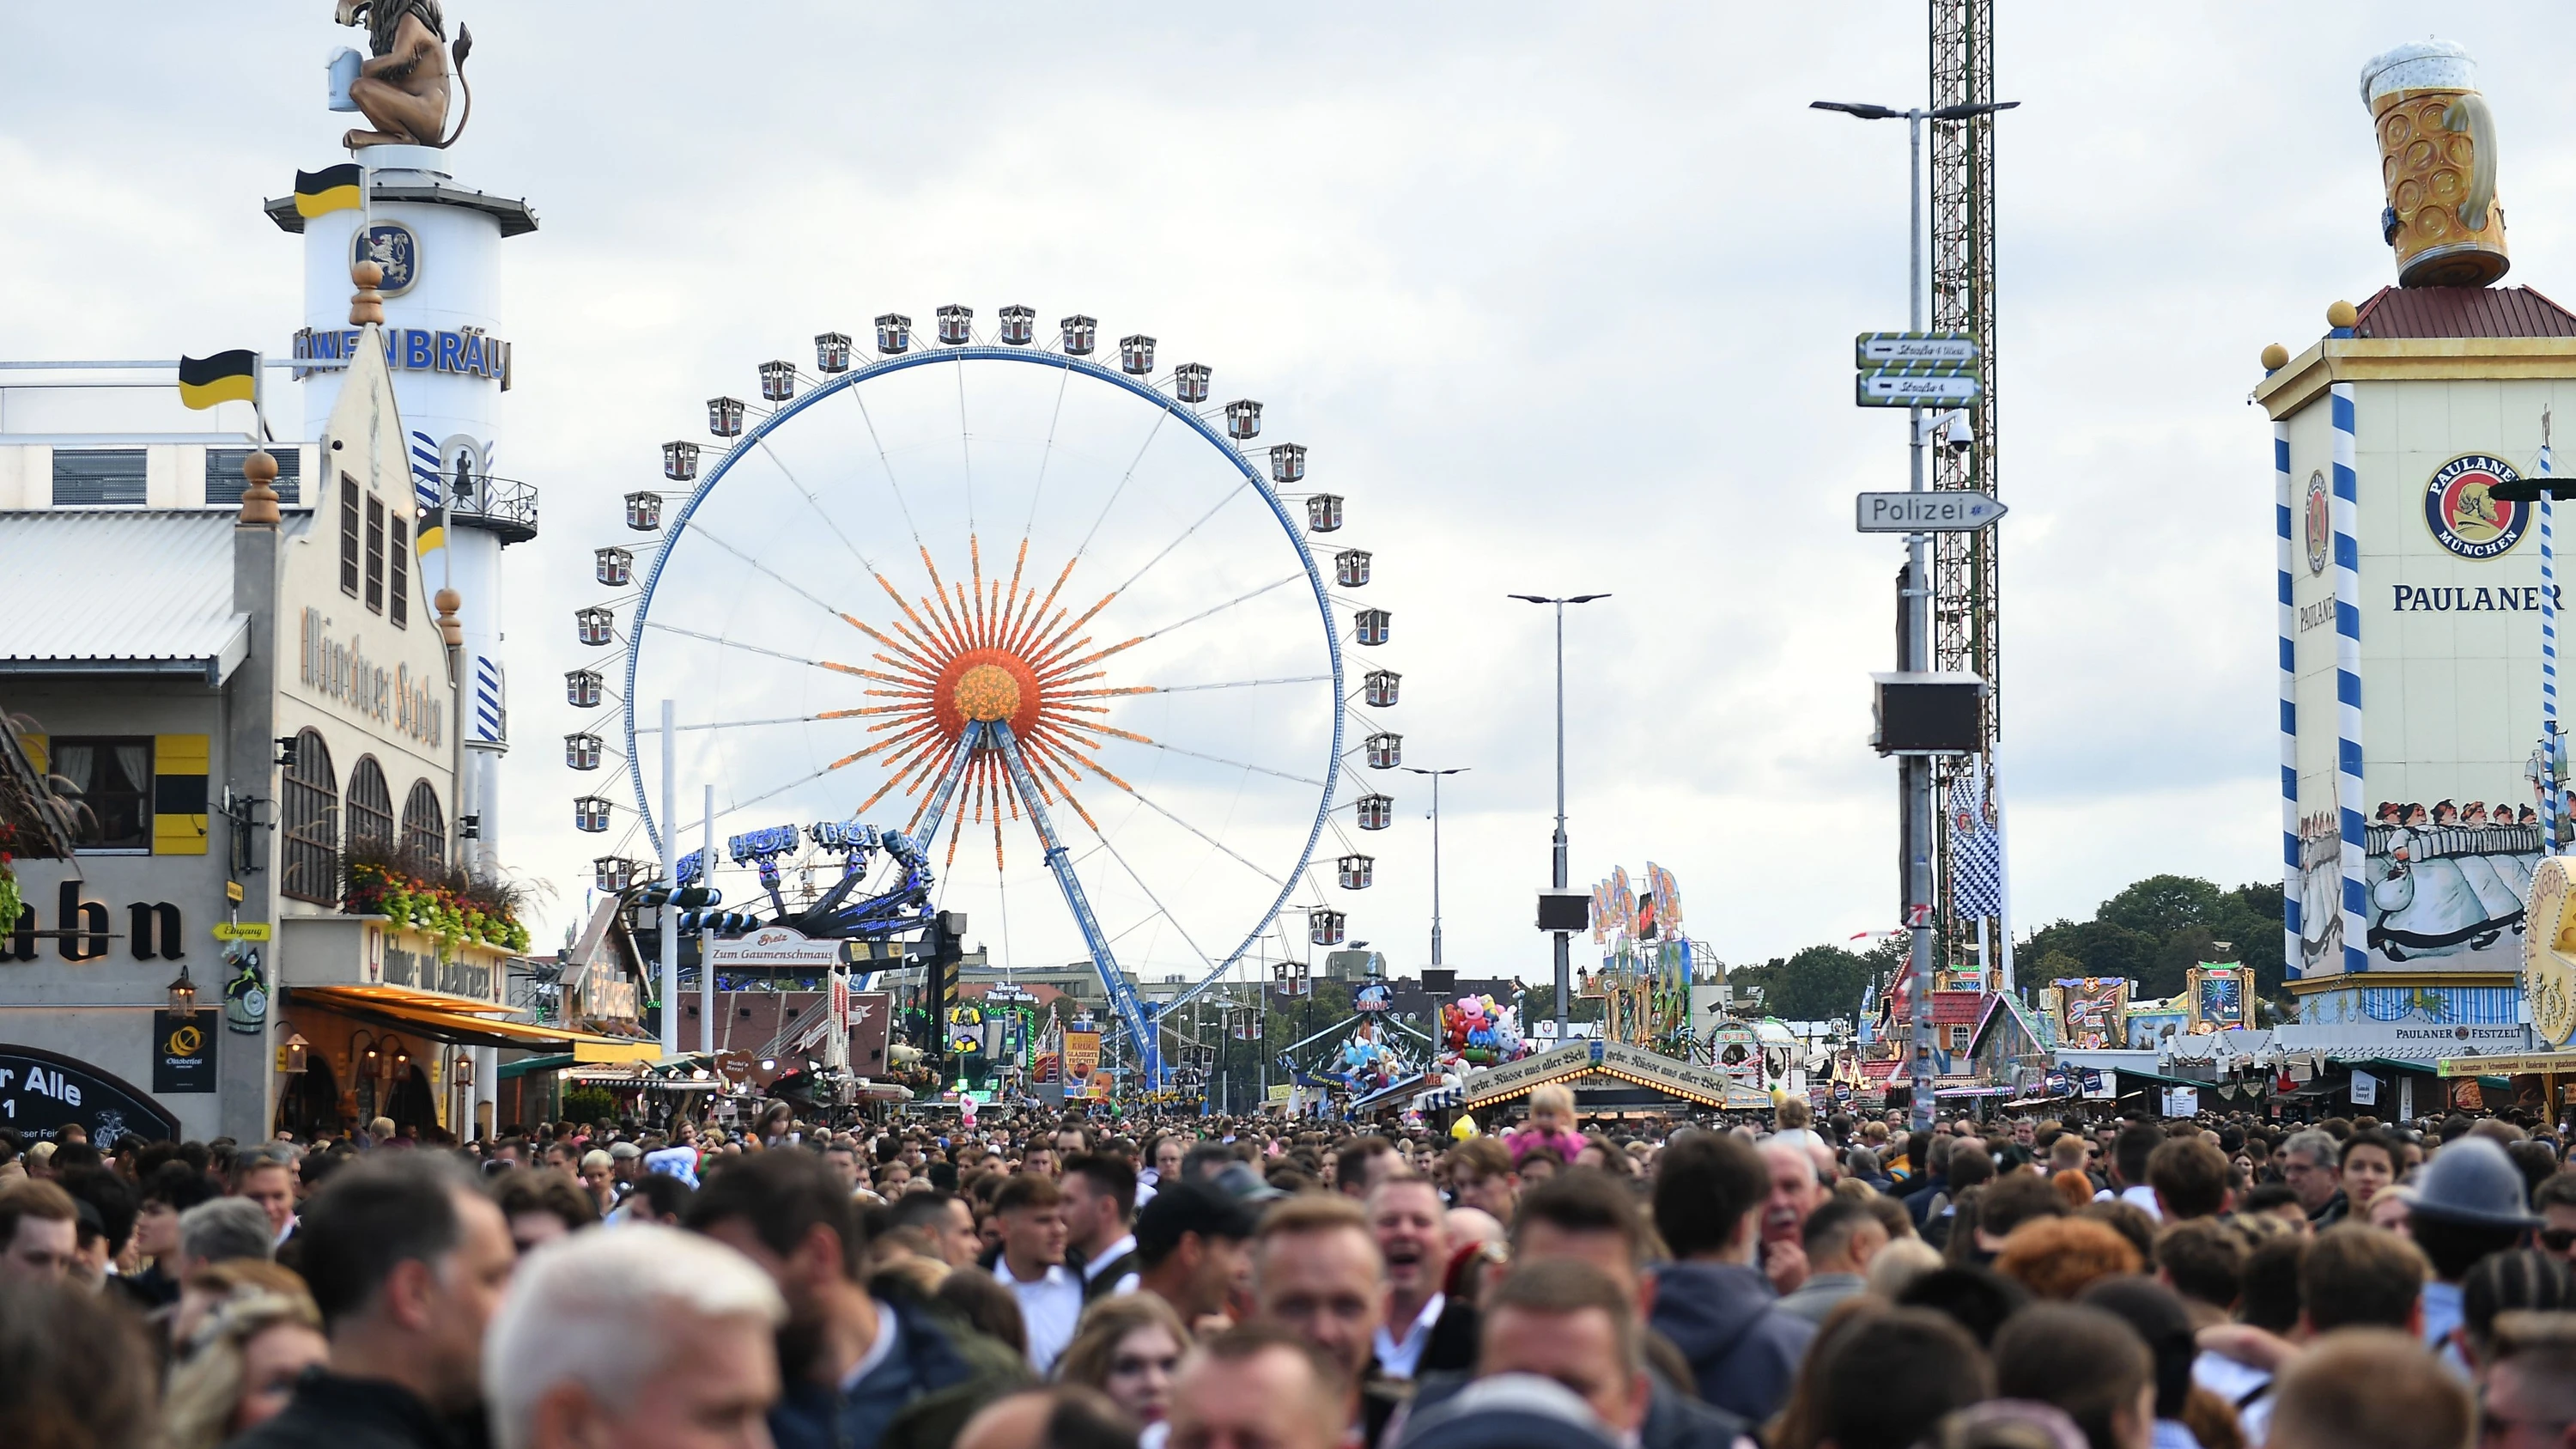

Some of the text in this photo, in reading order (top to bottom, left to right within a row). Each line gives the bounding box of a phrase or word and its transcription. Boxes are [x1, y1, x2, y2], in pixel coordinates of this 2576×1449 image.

[2429, 457, 2520, 496] PAULANE
[1874, 498, 1963, 521] Polizei
[2439, 530, 2518, 557] MÜNCHEN
[713, 948, 834, 960] Zum Gaumenschmaus
[1357, 1000, 1388, 1011] SHOP
[2396, 1027, 2521, 1038] PAULANER FESTZELT
[1524, 1066, 1541, 1076] aus
[1542, 1057, 1562, 1071] aller
[1563, 1049, 1586, 1064] Welt
[24, 1066, 82, 1107] Alle
[1425, 1074, 1442, 1086] Ma
[1661, 1067, 1678, 1079] aus
[1679, 1070, 1699, 1086] aller
[1701, 1075, 1724, 1093] Welt
